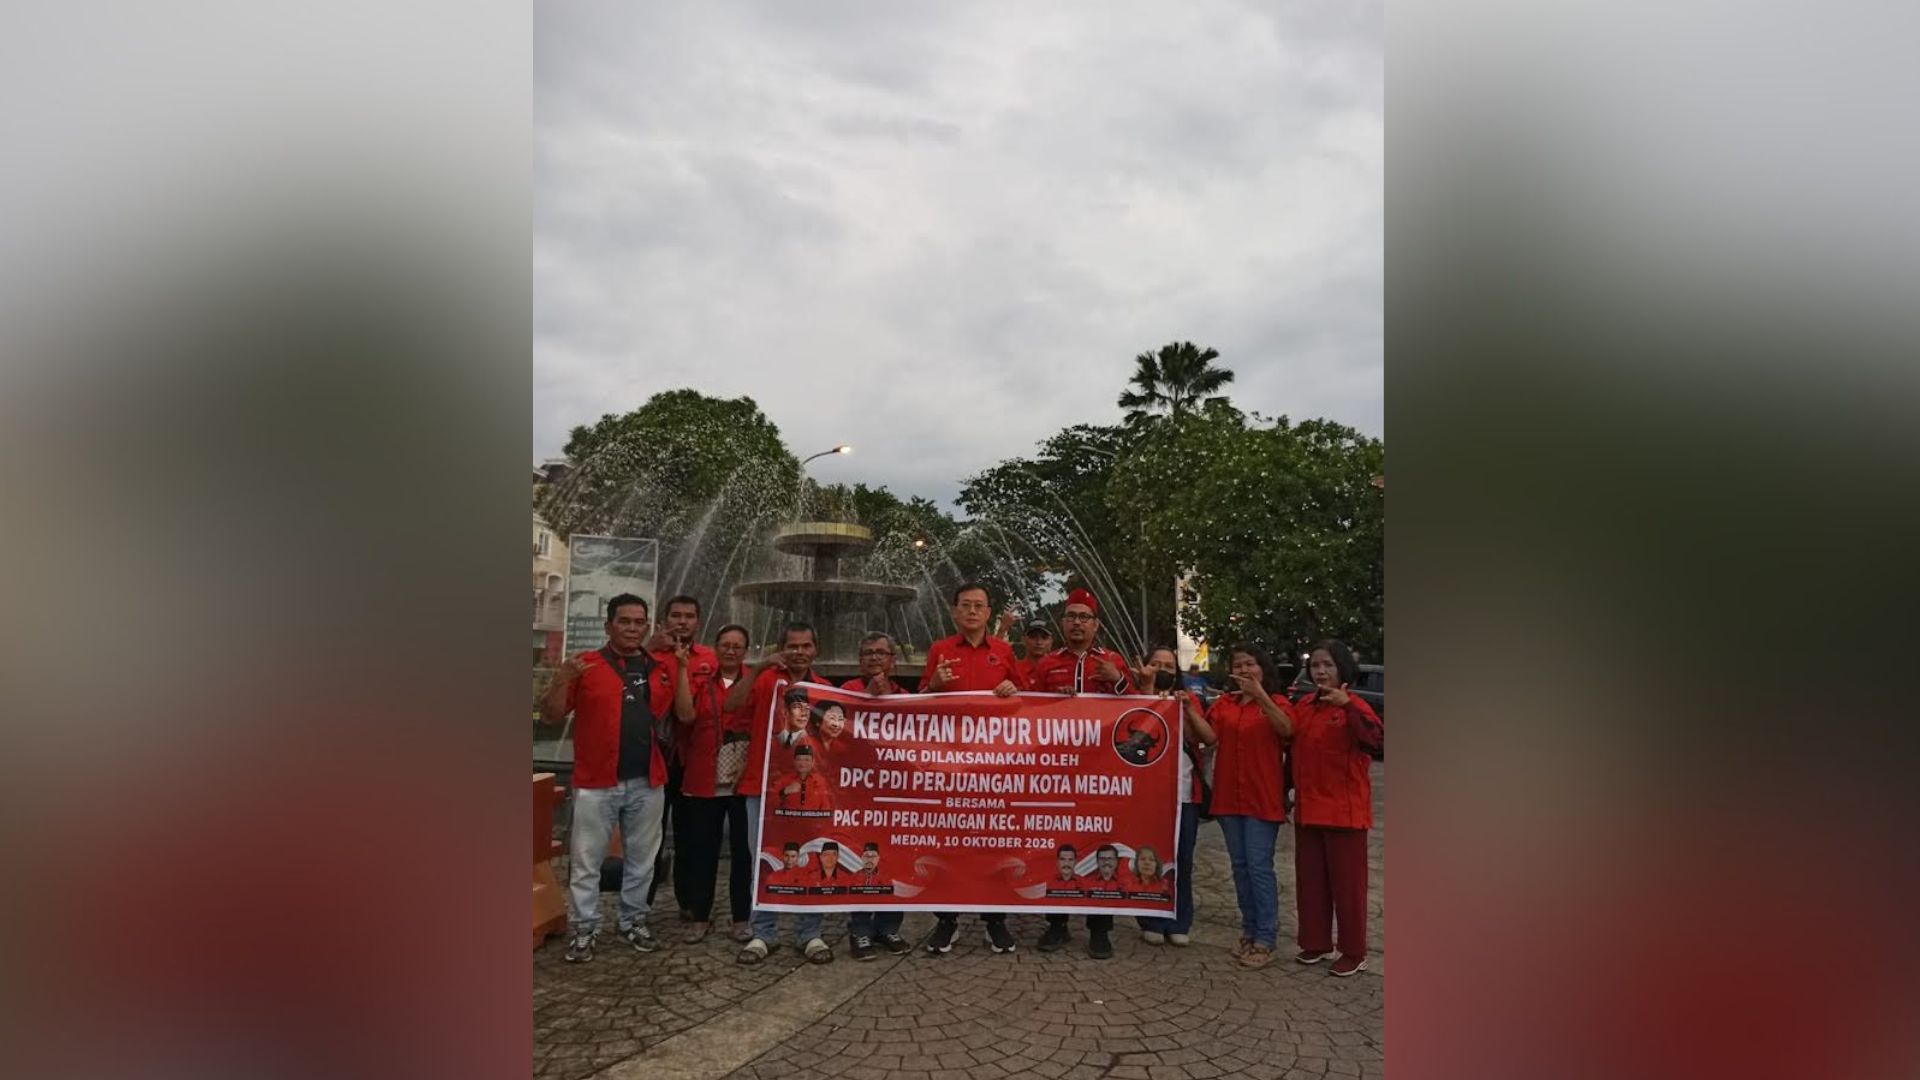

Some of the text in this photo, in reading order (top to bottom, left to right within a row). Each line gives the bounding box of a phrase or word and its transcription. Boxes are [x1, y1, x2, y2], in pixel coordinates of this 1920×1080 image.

[853, 711, 1101, 747] KEGIATAN DAPUR UMUM
[875, 748, 1079, 766] YANG DILAKSANAKAN OLEH
[840, 767, 1133, 796] DPC PDI PERJUANGAN KOTA MEDAN
[945, 797, 1006, 809] BERSAMA
[833, 809, 860, 827] PAC
[863, 810, 887, 827] PDI
[891, 811, 985, 829] PERJUANGAN
[989, 814, 1020, 831] KEC.
[1024, 815, 1071, 831] MEDAN
[1075, 816, 1113, 832] BARU
[890, 834, 1055, 849] MEDAN, 10 OKTOBER 2026
